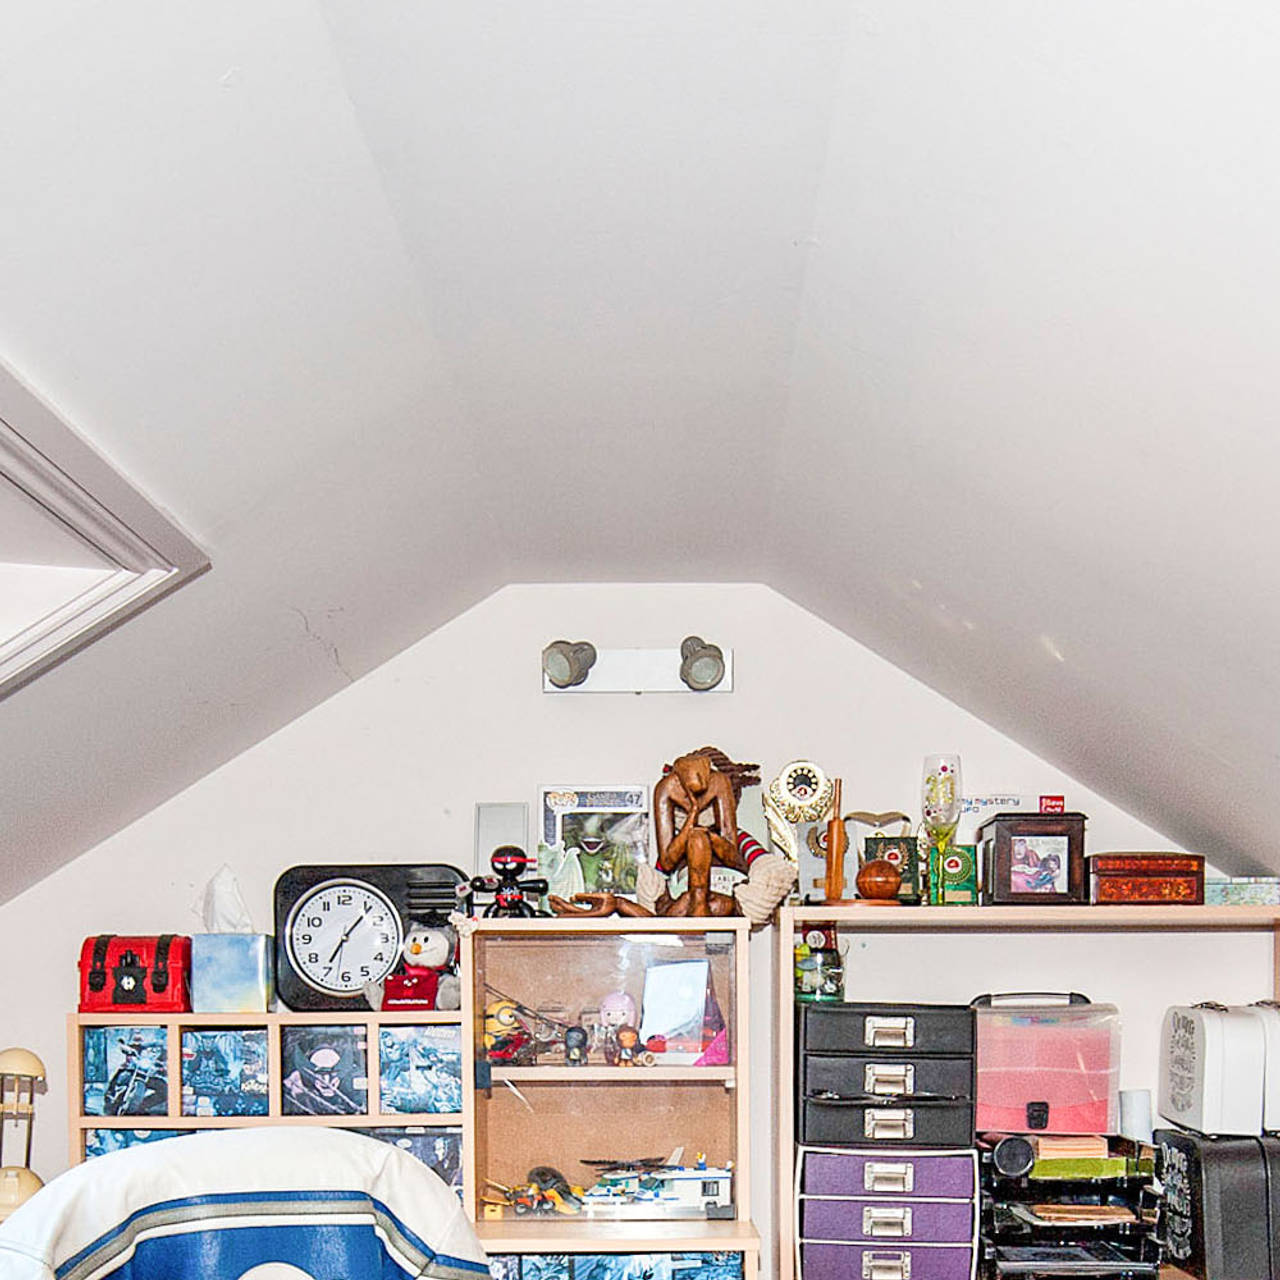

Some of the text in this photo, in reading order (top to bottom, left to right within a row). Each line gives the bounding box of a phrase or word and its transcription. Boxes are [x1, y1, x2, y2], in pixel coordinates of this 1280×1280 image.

[337, 895, 352, 906] 12
[322, 901, 331, 912] 11
[306, 916, 322, 928] 10
[372, 915, 384, 927] 2
[301, 934, 312, 945] 9
[379, 933, 389, 944] 3
[308, 953, 319, 964] 8
[373, 952, 384, 963] 4
[323, 967, 333, 978] 7
[360, 966, 370, 977] 5
[342, 972, 352, 983] 6
